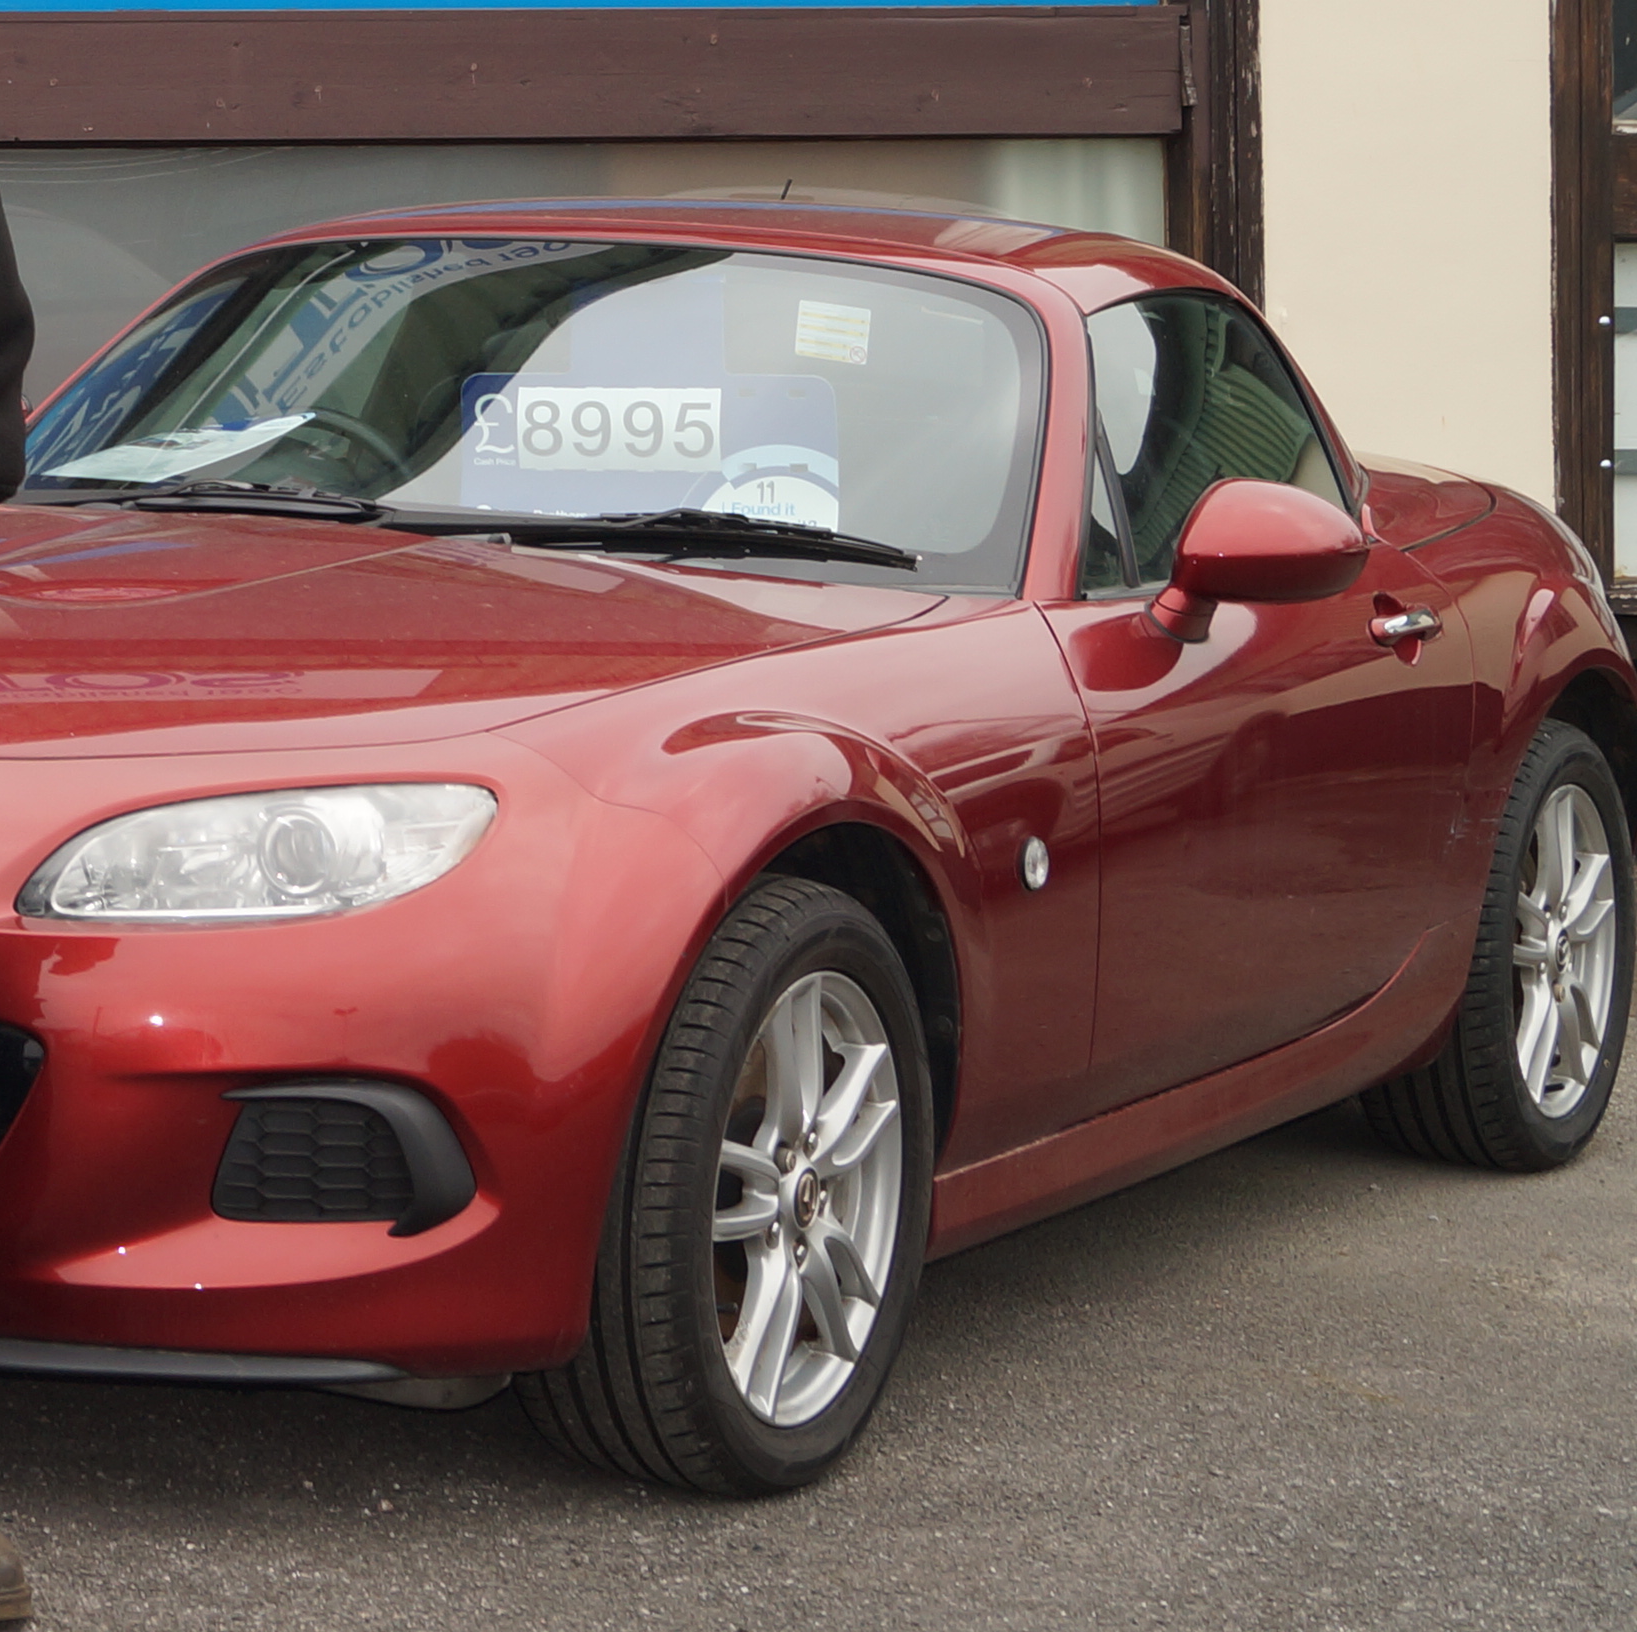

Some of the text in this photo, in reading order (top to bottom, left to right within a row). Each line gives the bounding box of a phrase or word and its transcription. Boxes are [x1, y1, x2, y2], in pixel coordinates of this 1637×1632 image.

[473, 393, 715, 459] £8995
[756, 480, 775, 504] 11
[731, 502, 796, 516] Found it
